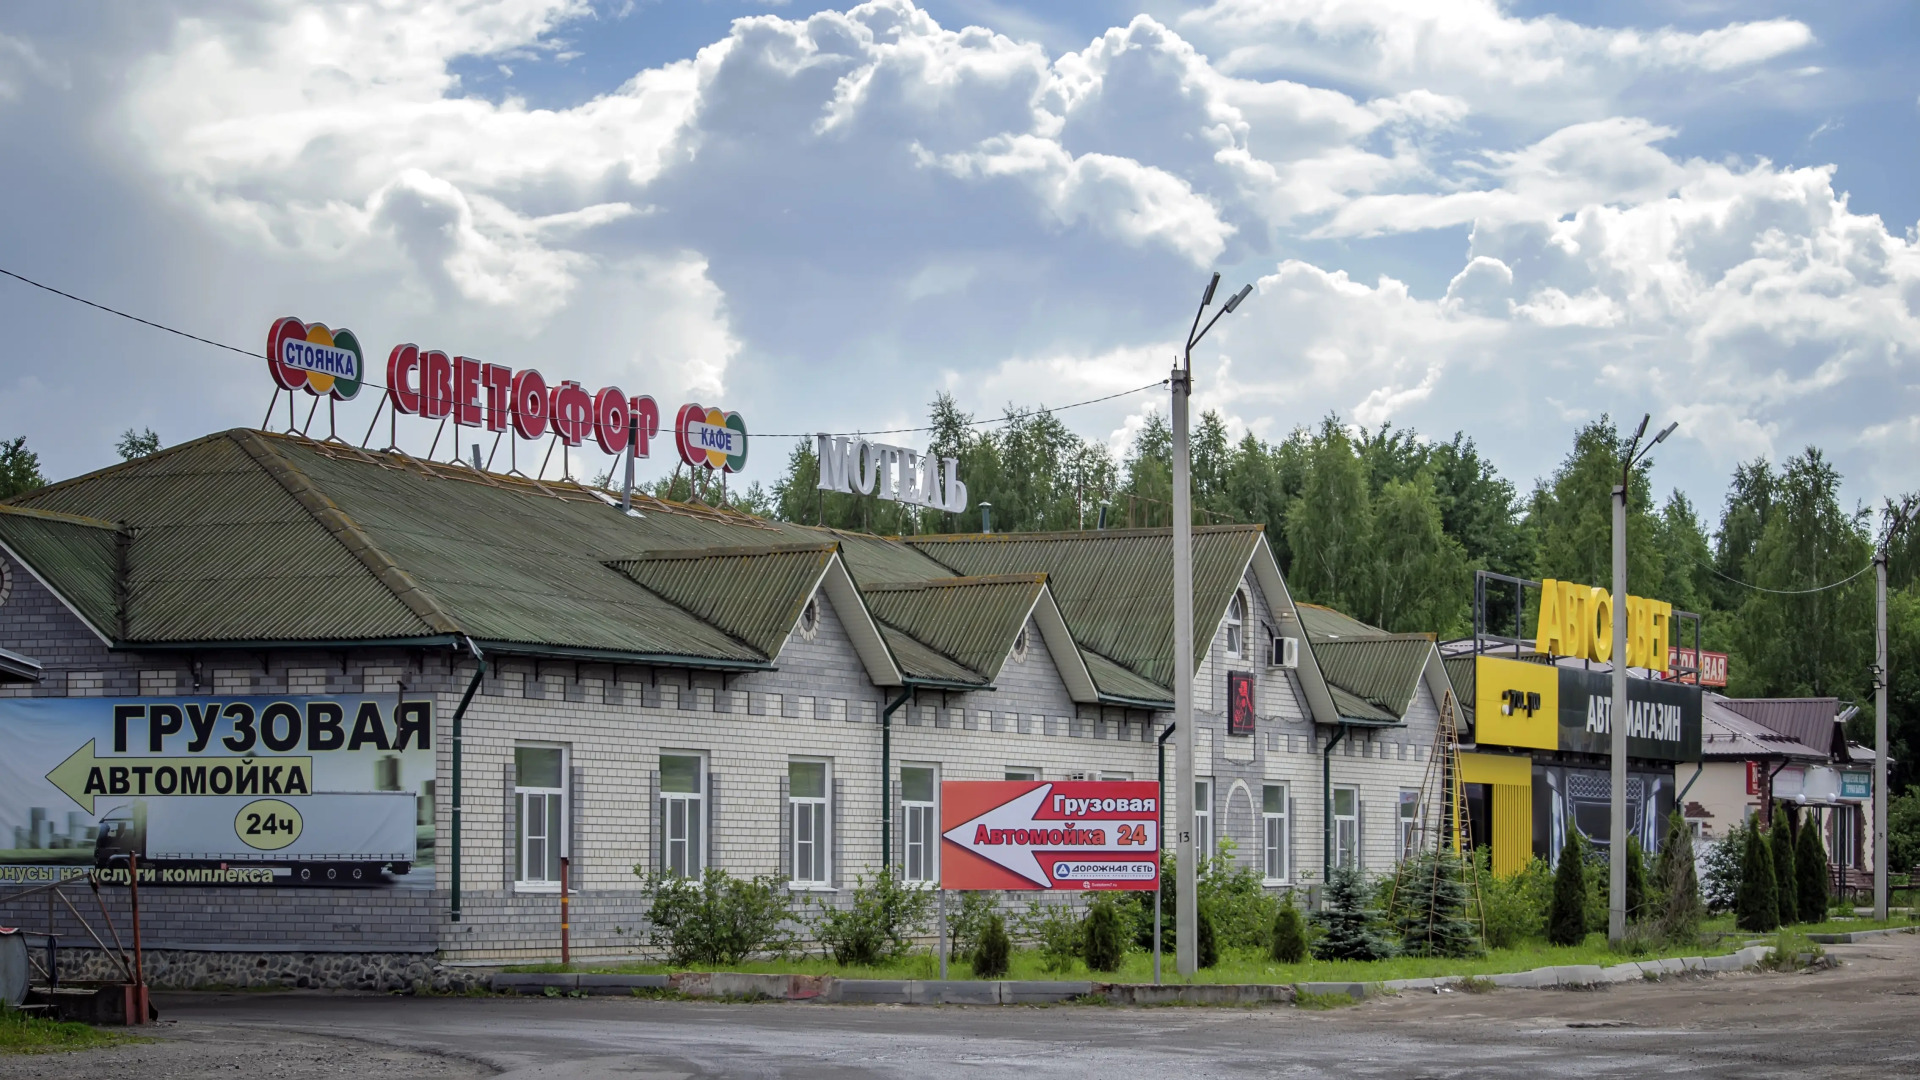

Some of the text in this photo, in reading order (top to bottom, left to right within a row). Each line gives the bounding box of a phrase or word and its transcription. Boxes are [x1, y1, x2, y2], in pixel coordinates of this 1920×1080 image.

[285, 341, 355, 378] СТОЯНКА
[386, 343, 660, 459] СВЕТОФОР
[701, 426, 733, 451] КАФЕ
[816, 432, 968, 514] МОТЕЛЬ
[113, 701, 431, 752] ГРУЗОВАЯ
[1586, 694, 1682, 742] АВТМАГАЗИН
[84, 759, 308, 795] АВТОМОЙКА
[1053, 794, 1156, 816] Грузовая
[245, 813, 294, 835] 24ч
[974, 823, 1147, 845] Автомойка 24
[1178, 831, 1190, 843] 13
[162, 867, 274, 883] комплекса
[1071, 864, 1153, 873] ДОРОЖНАЯ СЕТЬ
